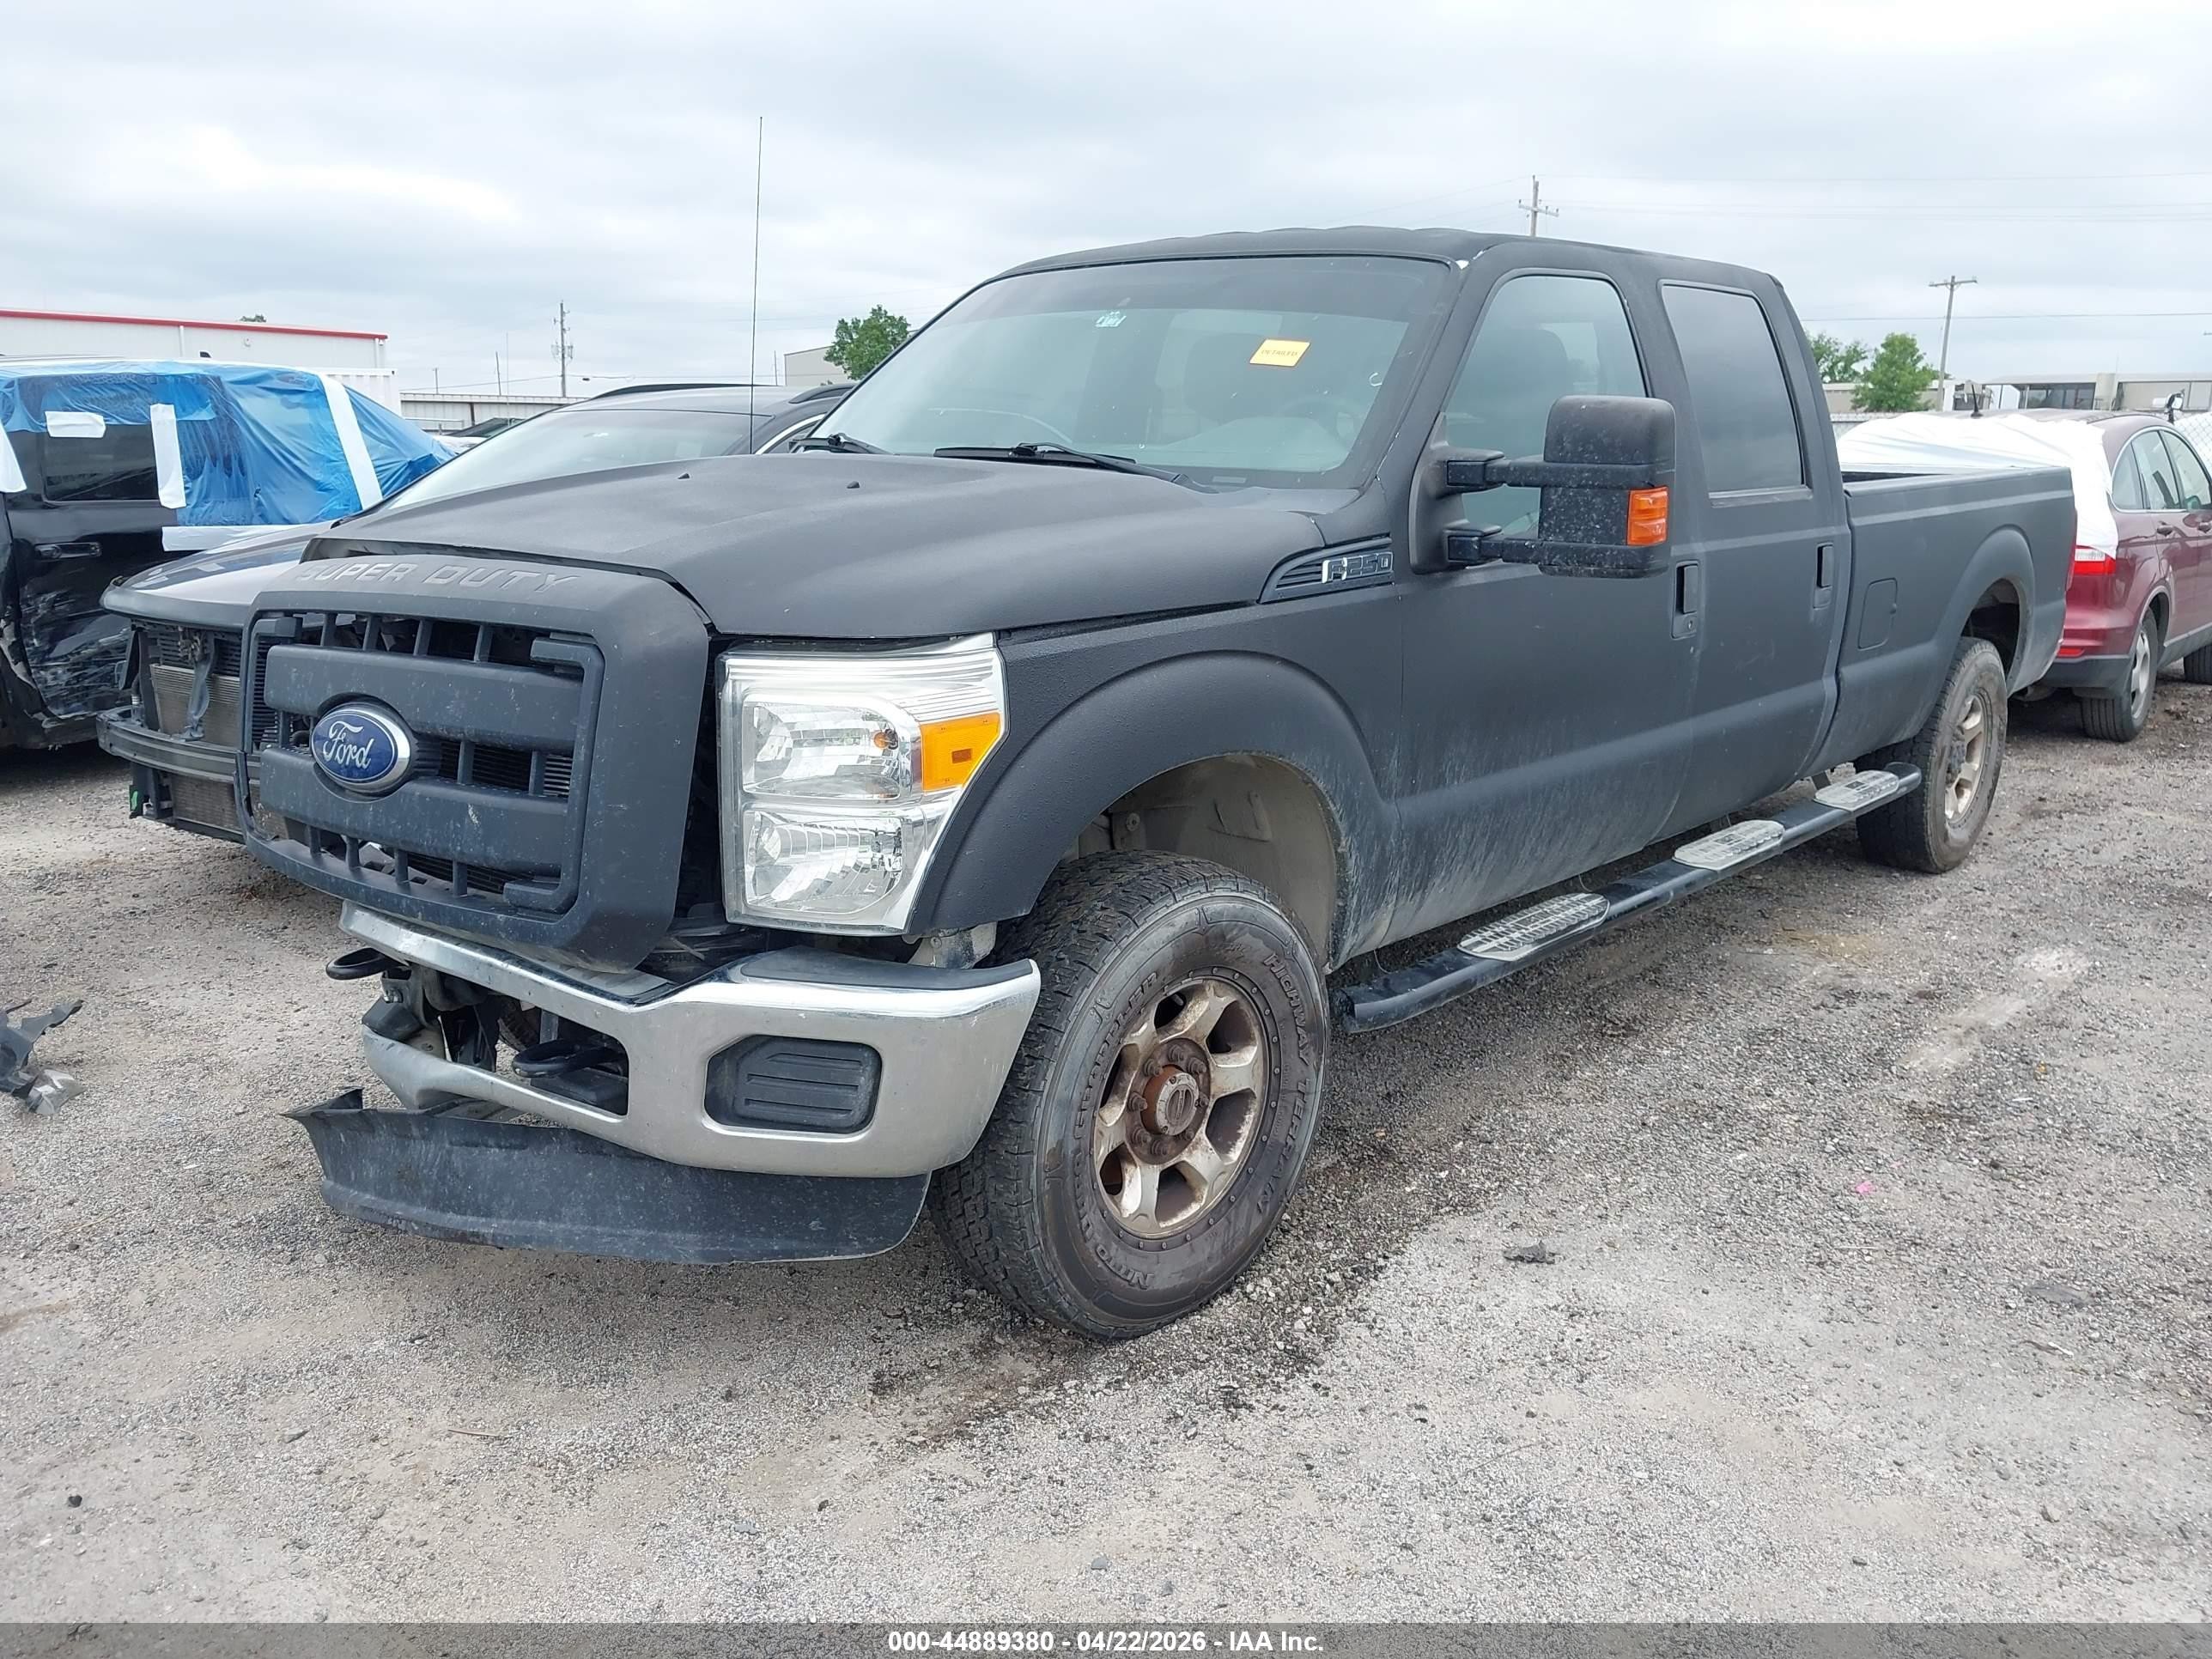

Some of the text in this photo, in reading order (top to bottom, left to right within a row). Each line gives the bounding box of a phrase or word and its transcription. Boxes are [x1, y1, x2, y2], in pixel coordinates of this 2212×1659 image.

[297, 562, 580, 592] SUPER DUTY
[324, 720, 376, 770] Ford
[1255, 951, 1312, 1214] HIGHWAY TERRAIN
